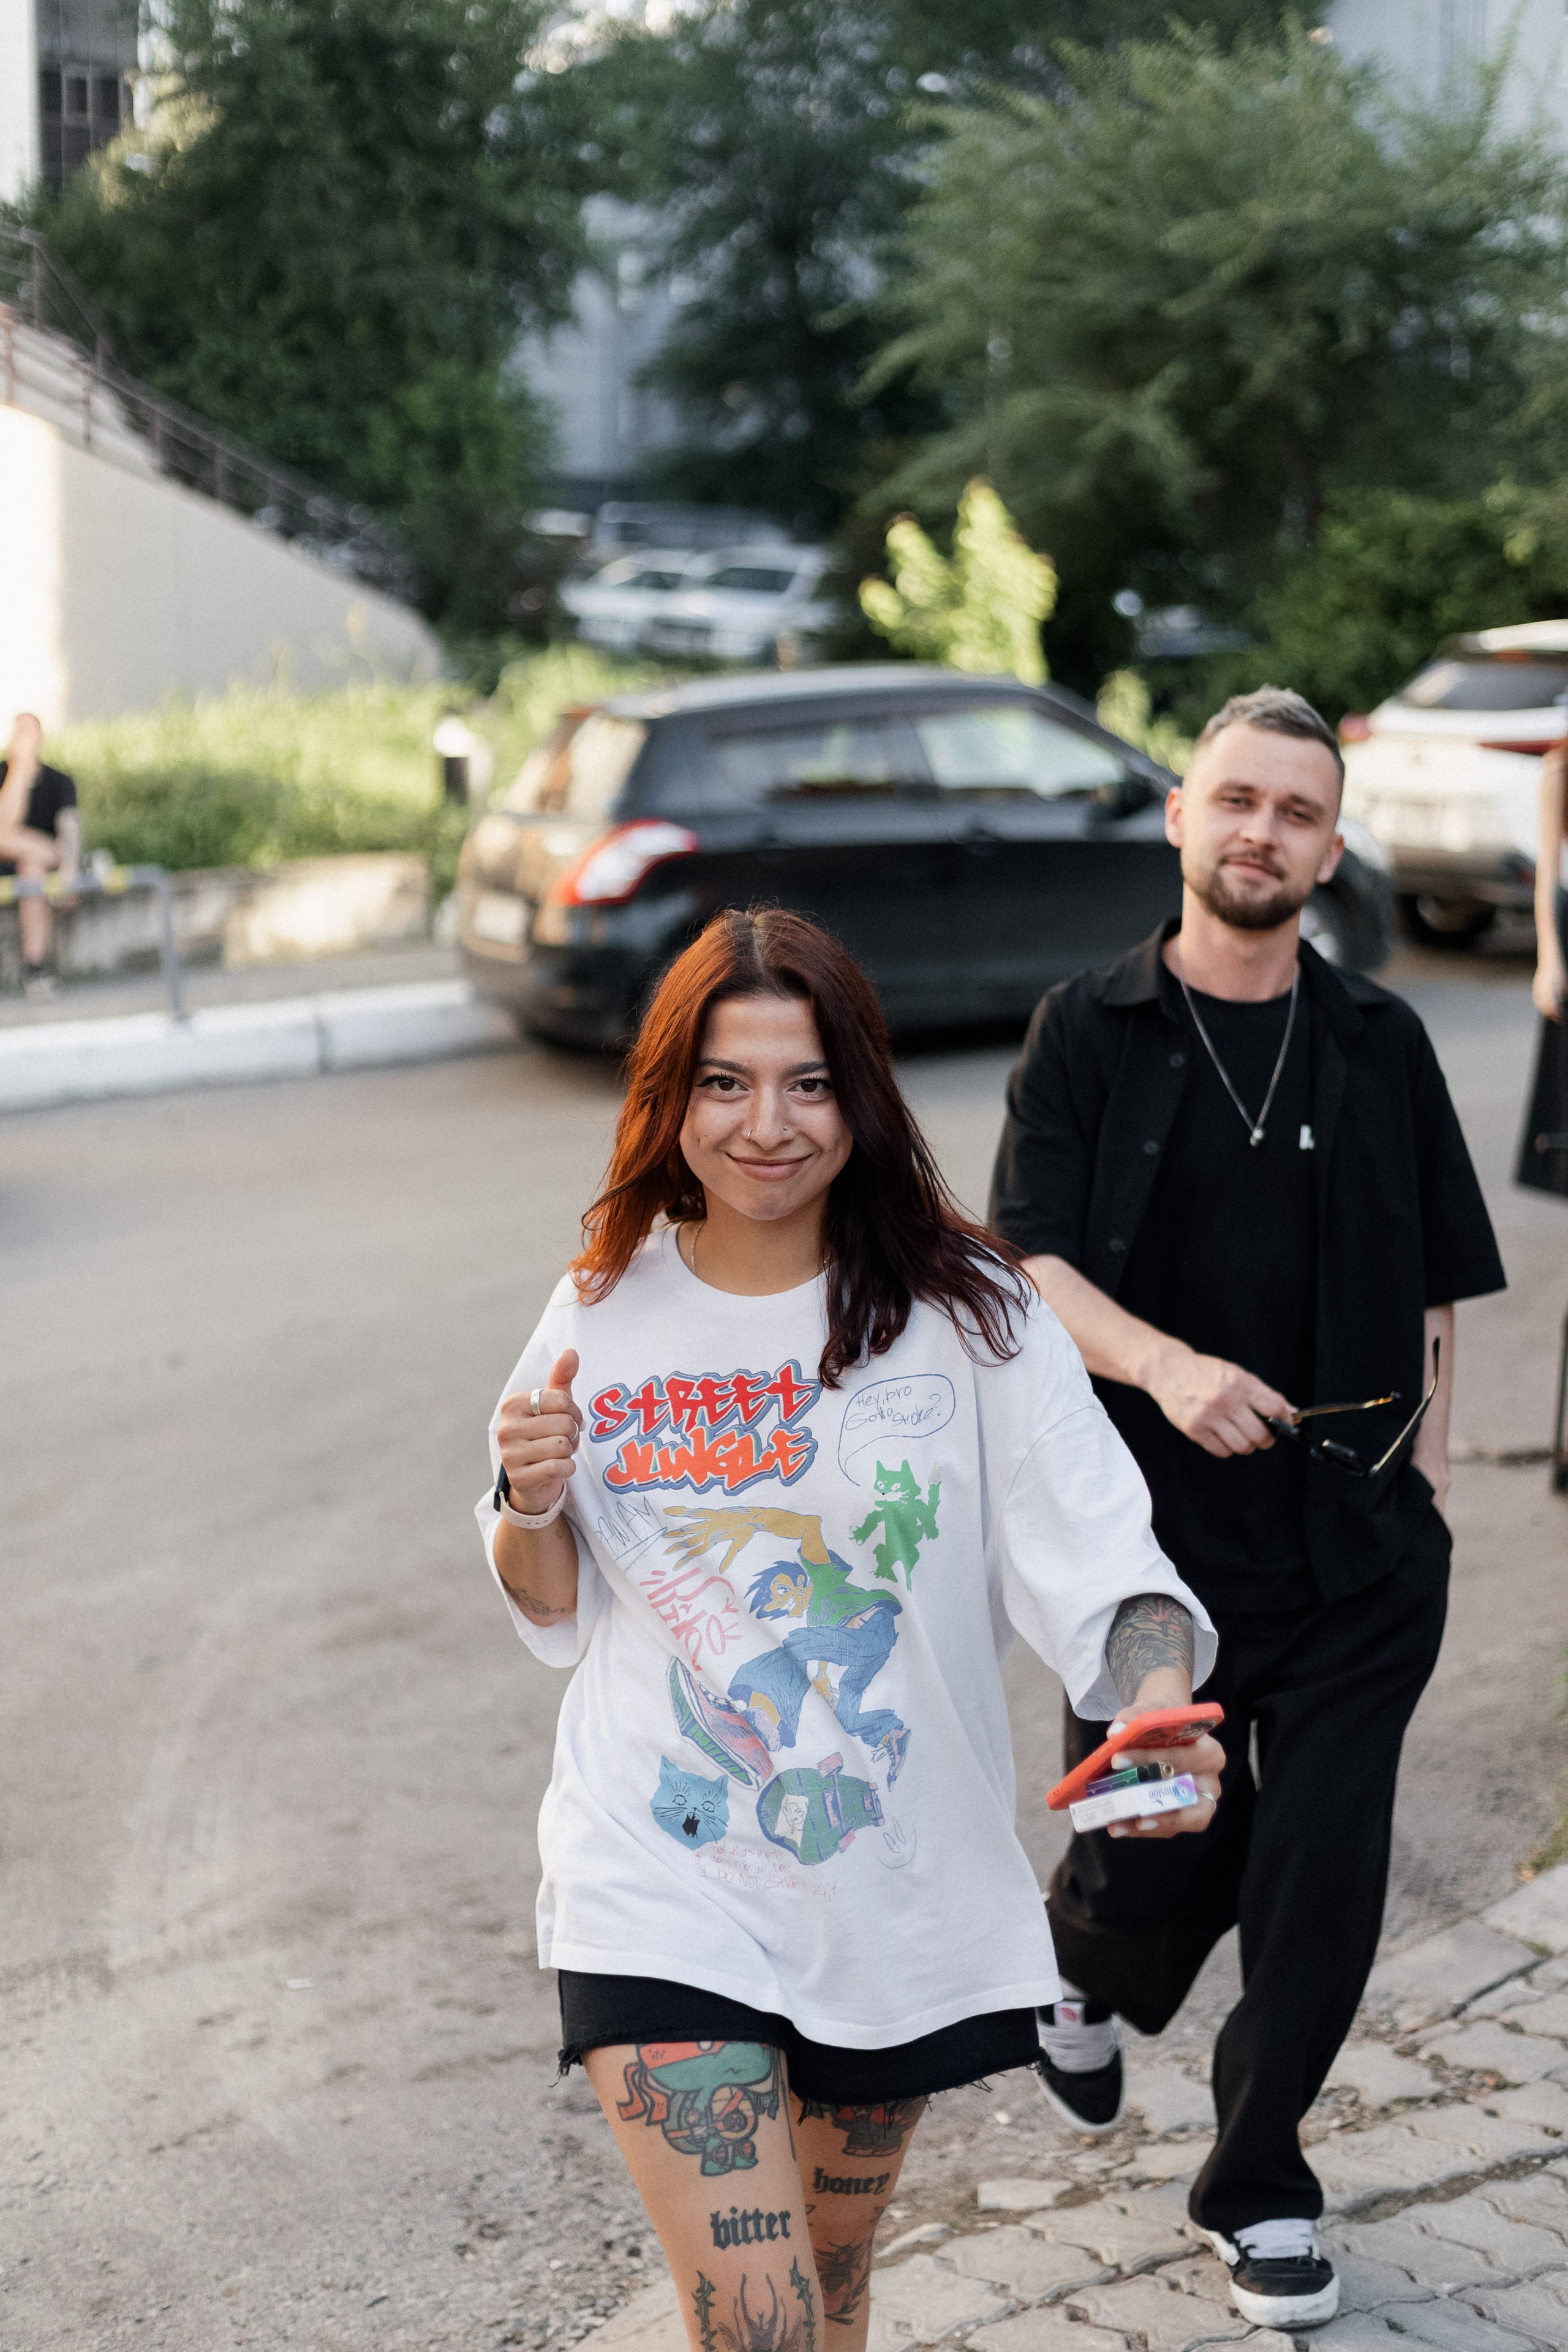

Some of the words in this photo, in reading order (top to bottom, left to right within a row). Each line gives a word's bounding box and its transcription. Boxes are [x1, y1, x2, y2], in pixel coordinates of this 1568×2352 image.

[603, 1424, 818, 1496] JUNGLE
[1148, 1785, 1181, 1800] Winston
[739, 1873, 763, 1890] NOT
[812, 2165, 889, 2195] honey
[710, 2206, 791, 2250] bitter
